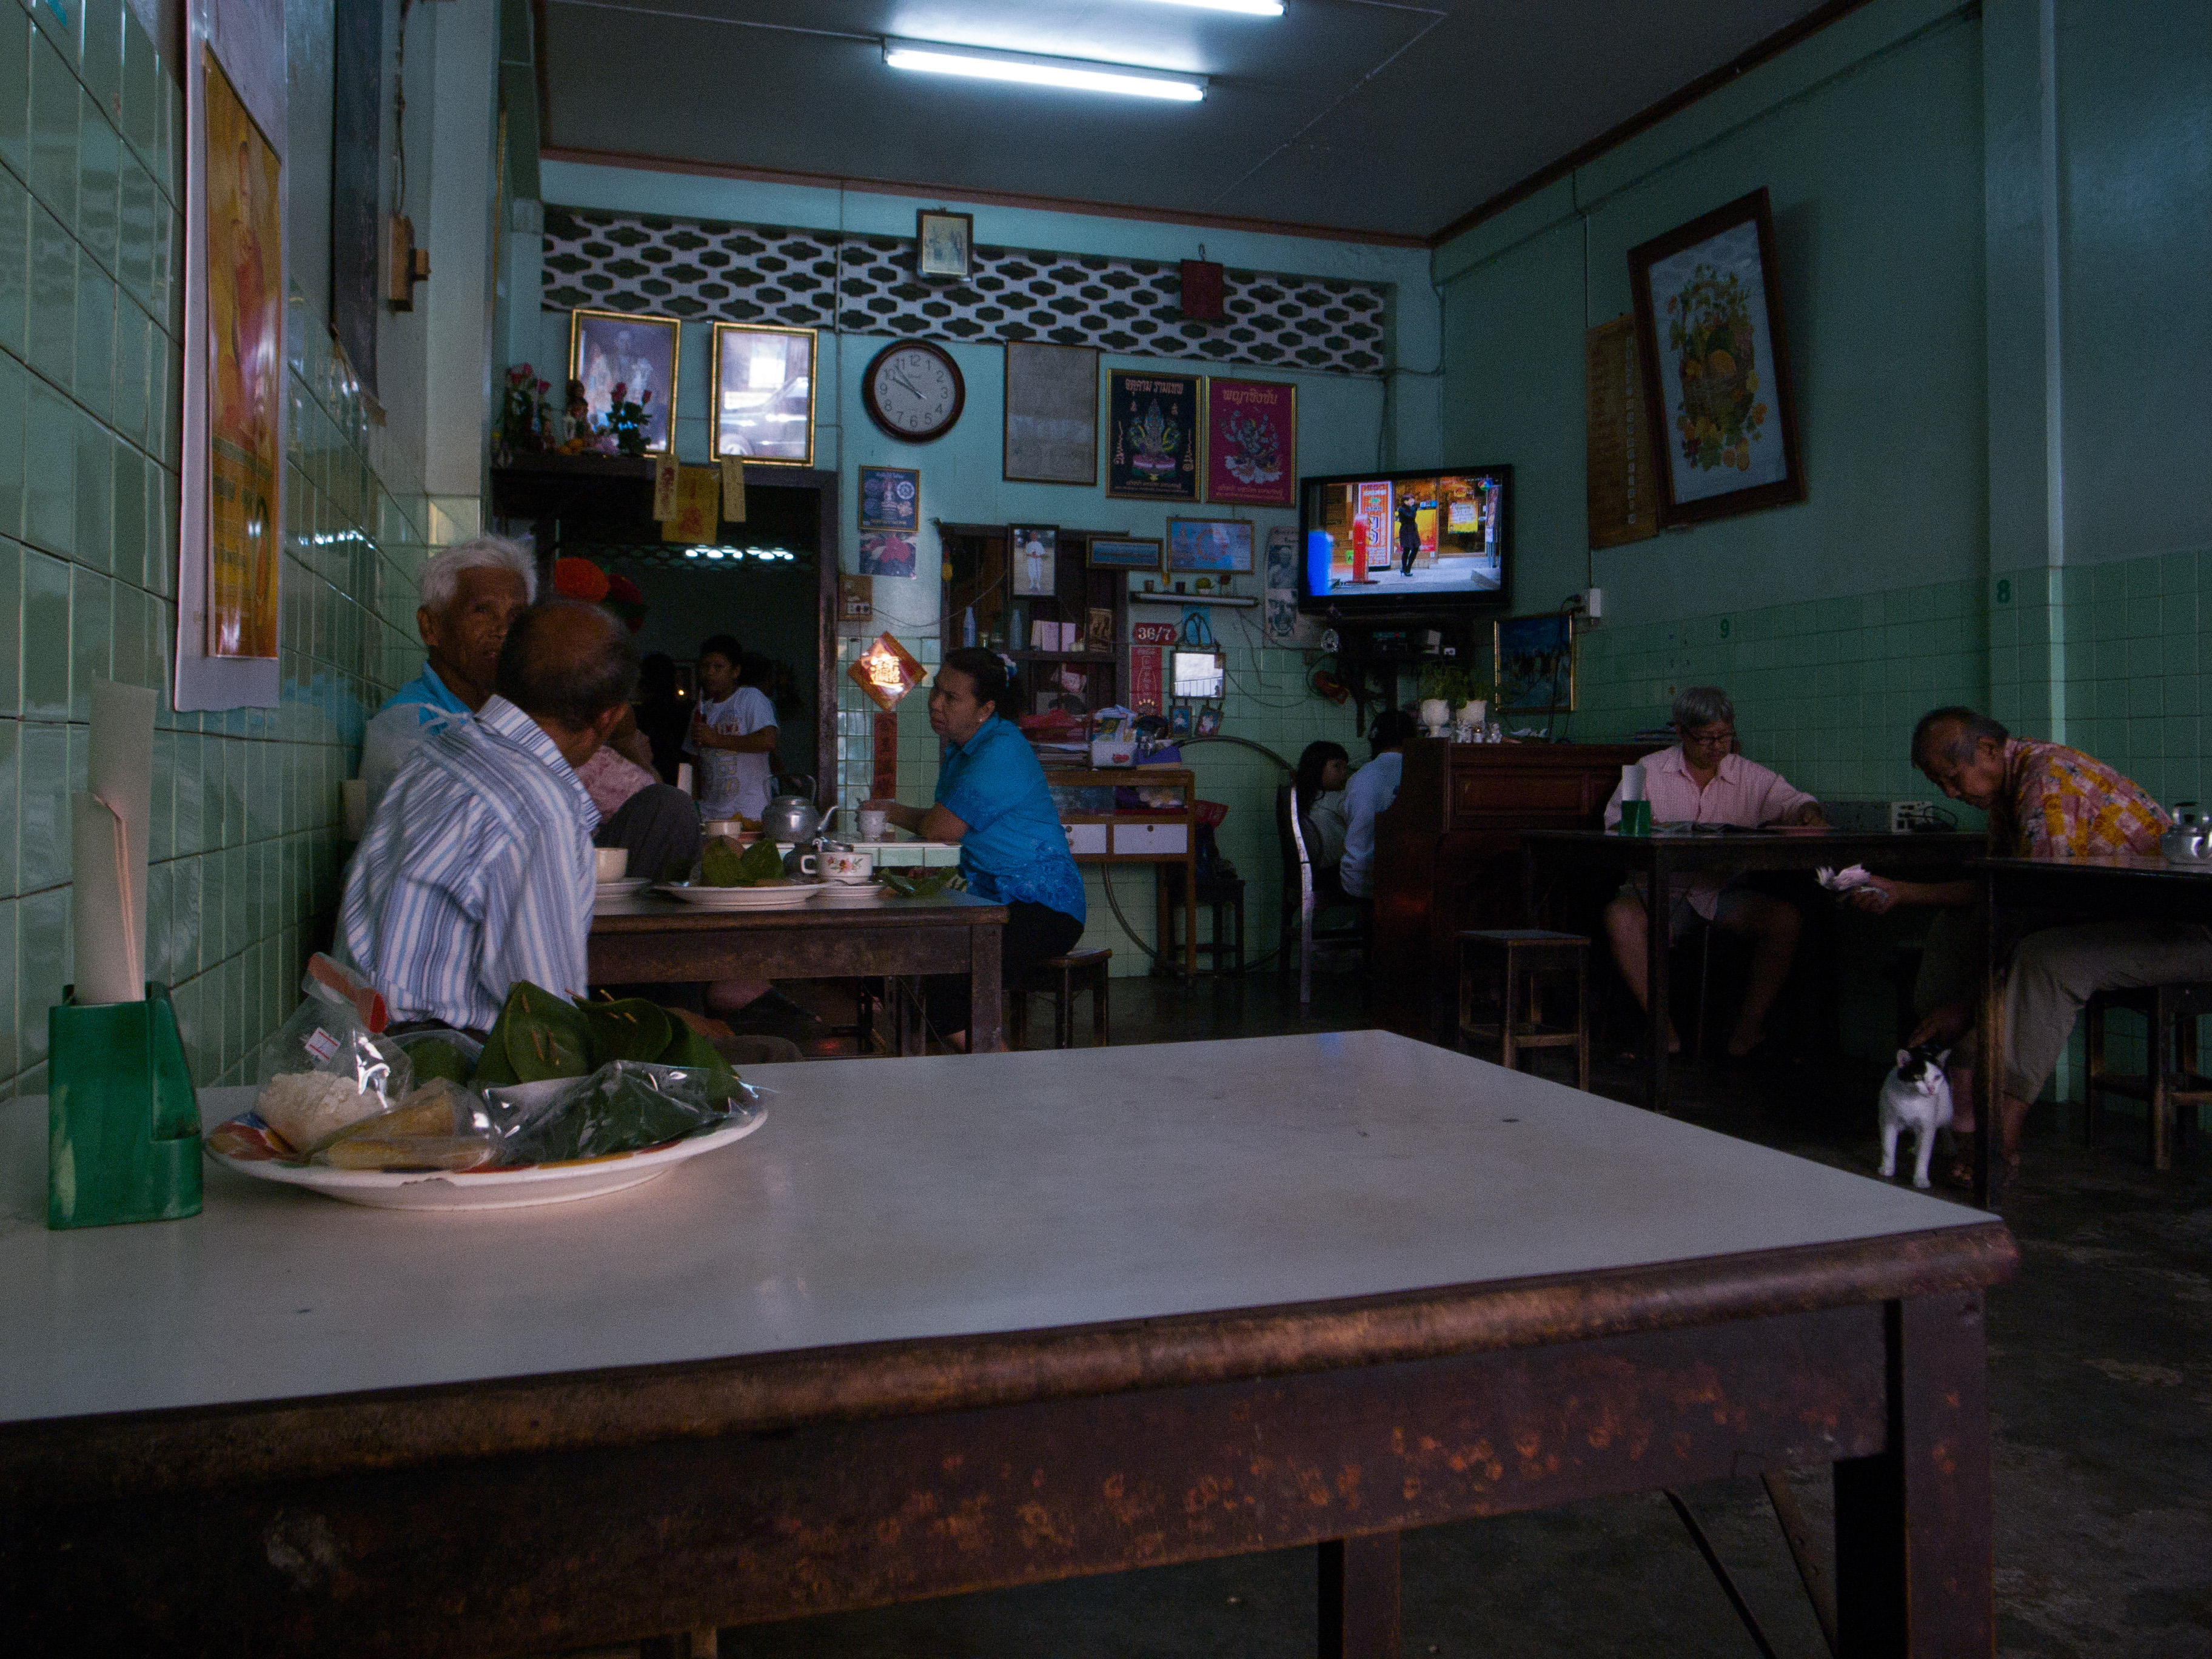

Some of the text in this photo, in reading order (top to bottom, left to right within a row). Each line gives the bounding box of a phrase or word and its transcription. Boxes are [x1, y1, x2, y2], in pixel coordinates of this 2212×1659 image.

[910, 354, 921, 367] 12
[884, 369, 896, 381] 10
[936, 370, 944, 383] 2
[879, 383, 888, 395] 9
[941, 387, 948, 399] 3
[884, 399, 892, 412] 8
[935, 404, 943, 414] 4
[897, 411, 903, 423] 7
[910, 415, 917, 427] 6
[925, 412, 932, 424] 5
[1997, 578, 2011, 604] 8
[1720, 618, 1729, 638] 9
